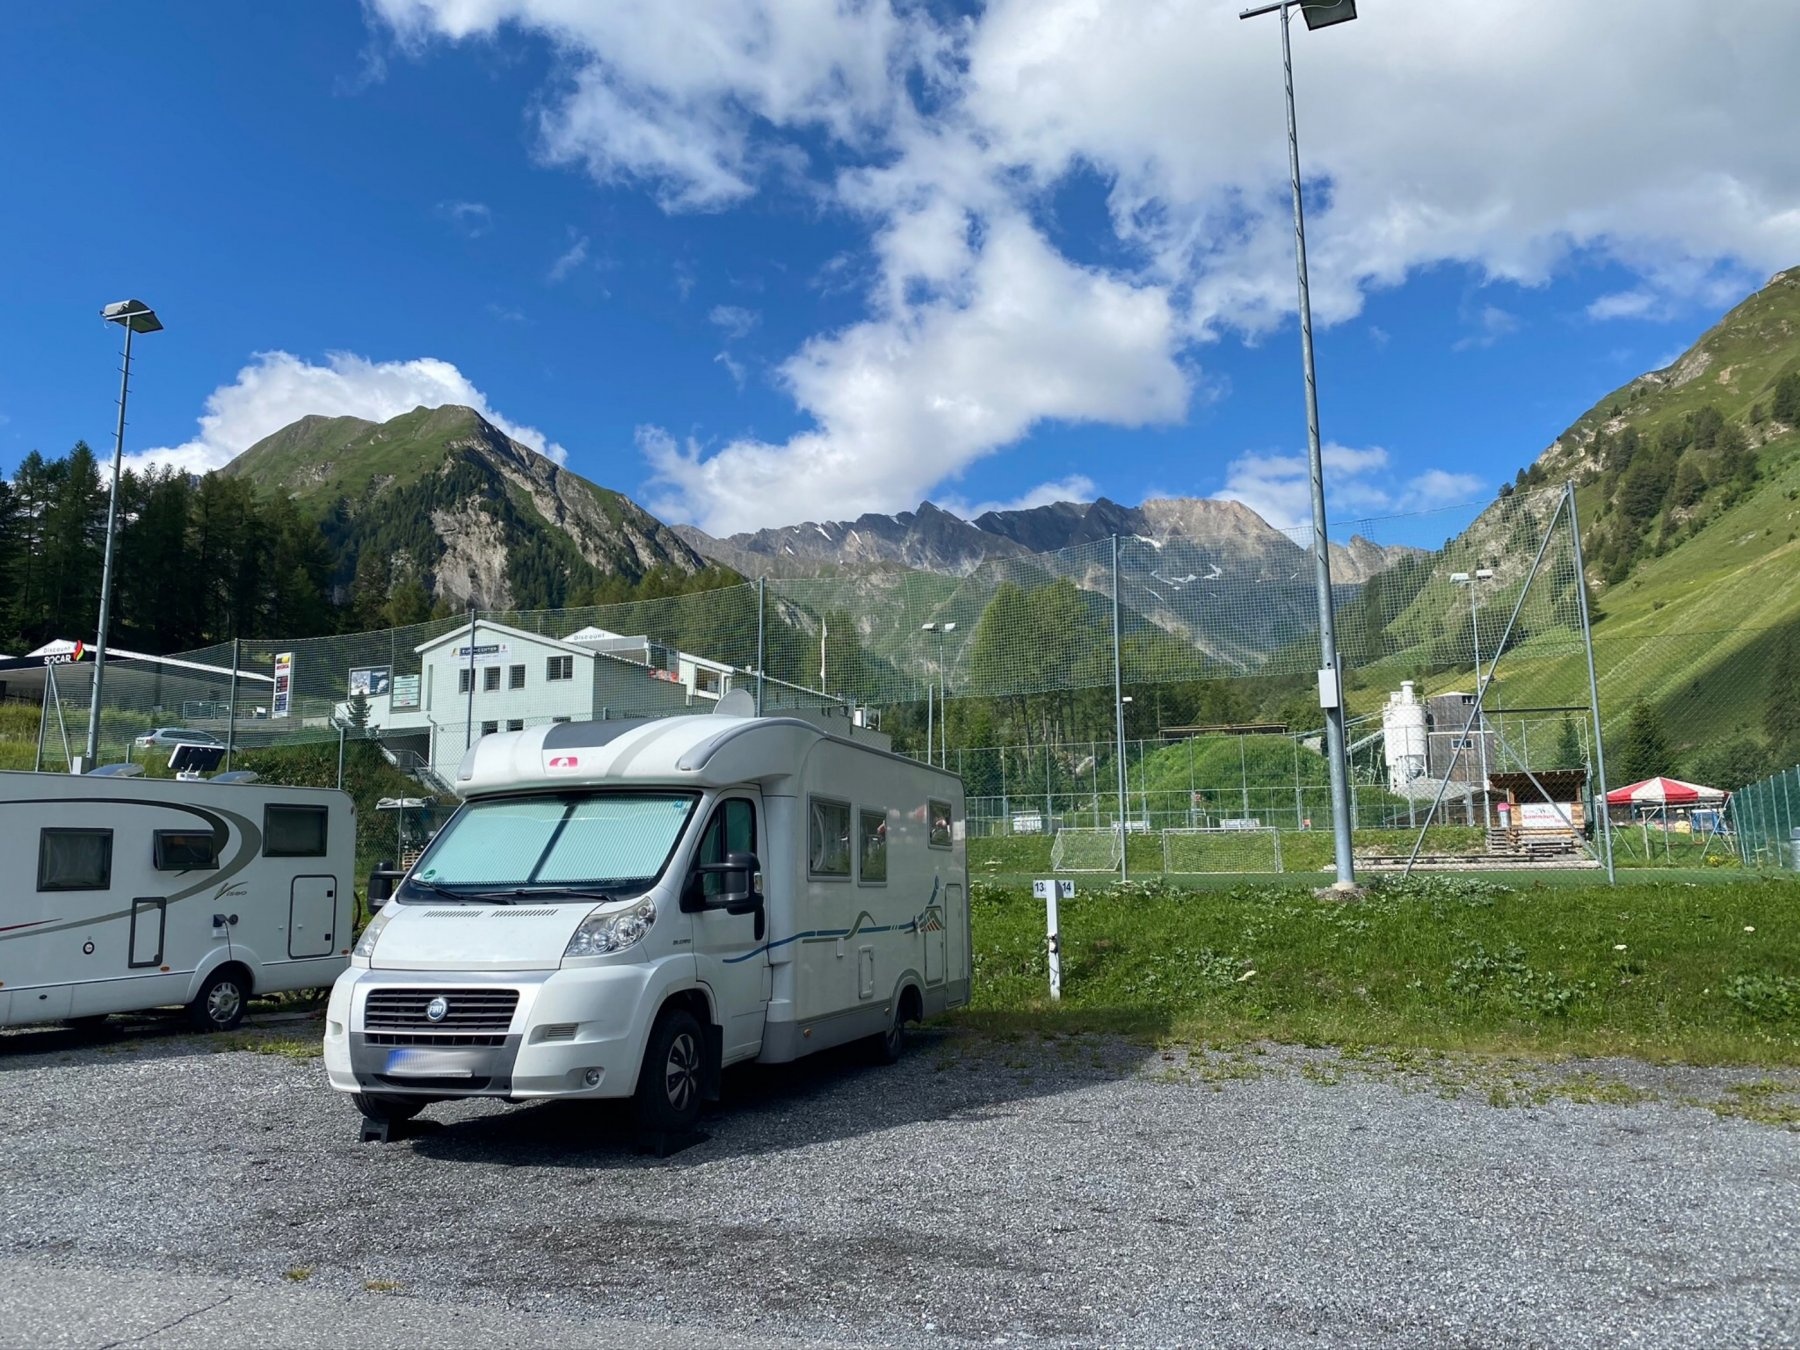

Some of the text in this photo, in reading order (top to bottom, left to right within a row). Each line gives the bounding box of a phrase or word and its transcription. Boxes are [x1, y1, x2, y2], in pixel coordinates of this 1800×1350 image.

[573, 632, 605, 640] Discount
[43, 645, 71, 654] Discount
[43, 654, 72, 665] SOCAR
[1035, 882, 1045, 892] 13
[1062, 882, 1072, 892] 14
